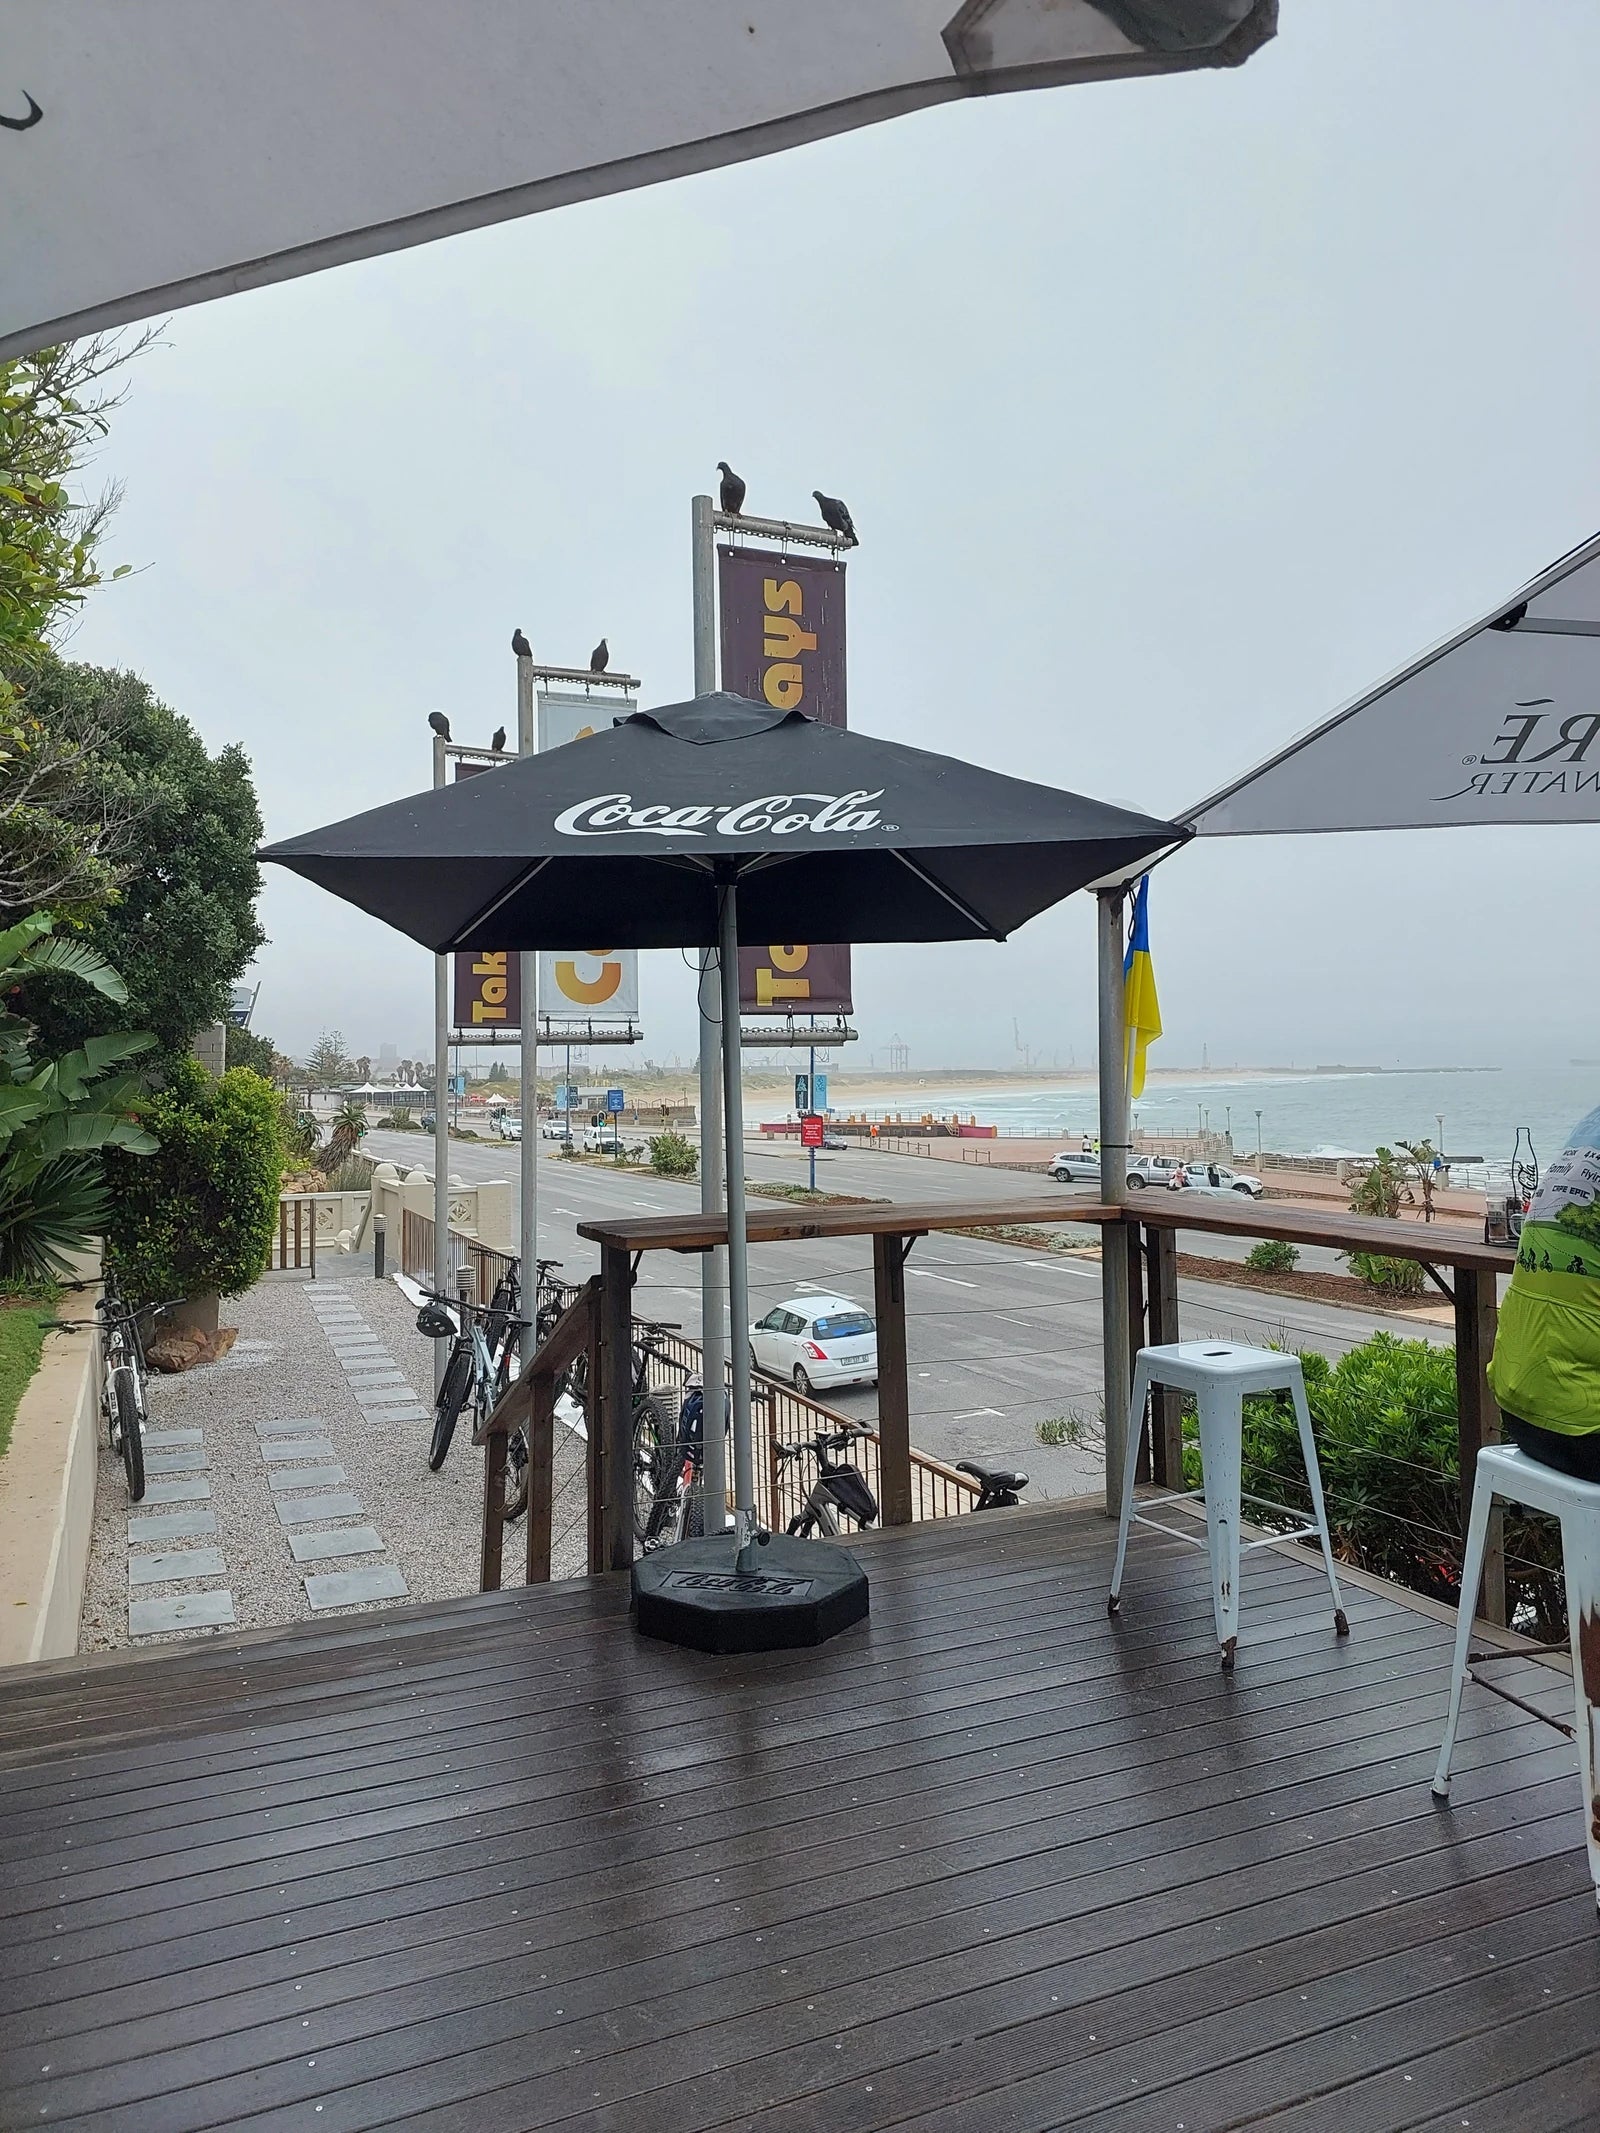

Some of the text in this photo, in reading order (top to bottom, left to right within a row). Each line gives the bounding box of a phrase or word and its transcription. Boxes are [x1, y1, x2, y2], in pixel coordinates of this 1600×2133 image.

[554, 788, 886, 836] Coca-Cola
[472, 952, 507, 1024] Tak
[1569, 1186, 1591, 1200] EPIC
